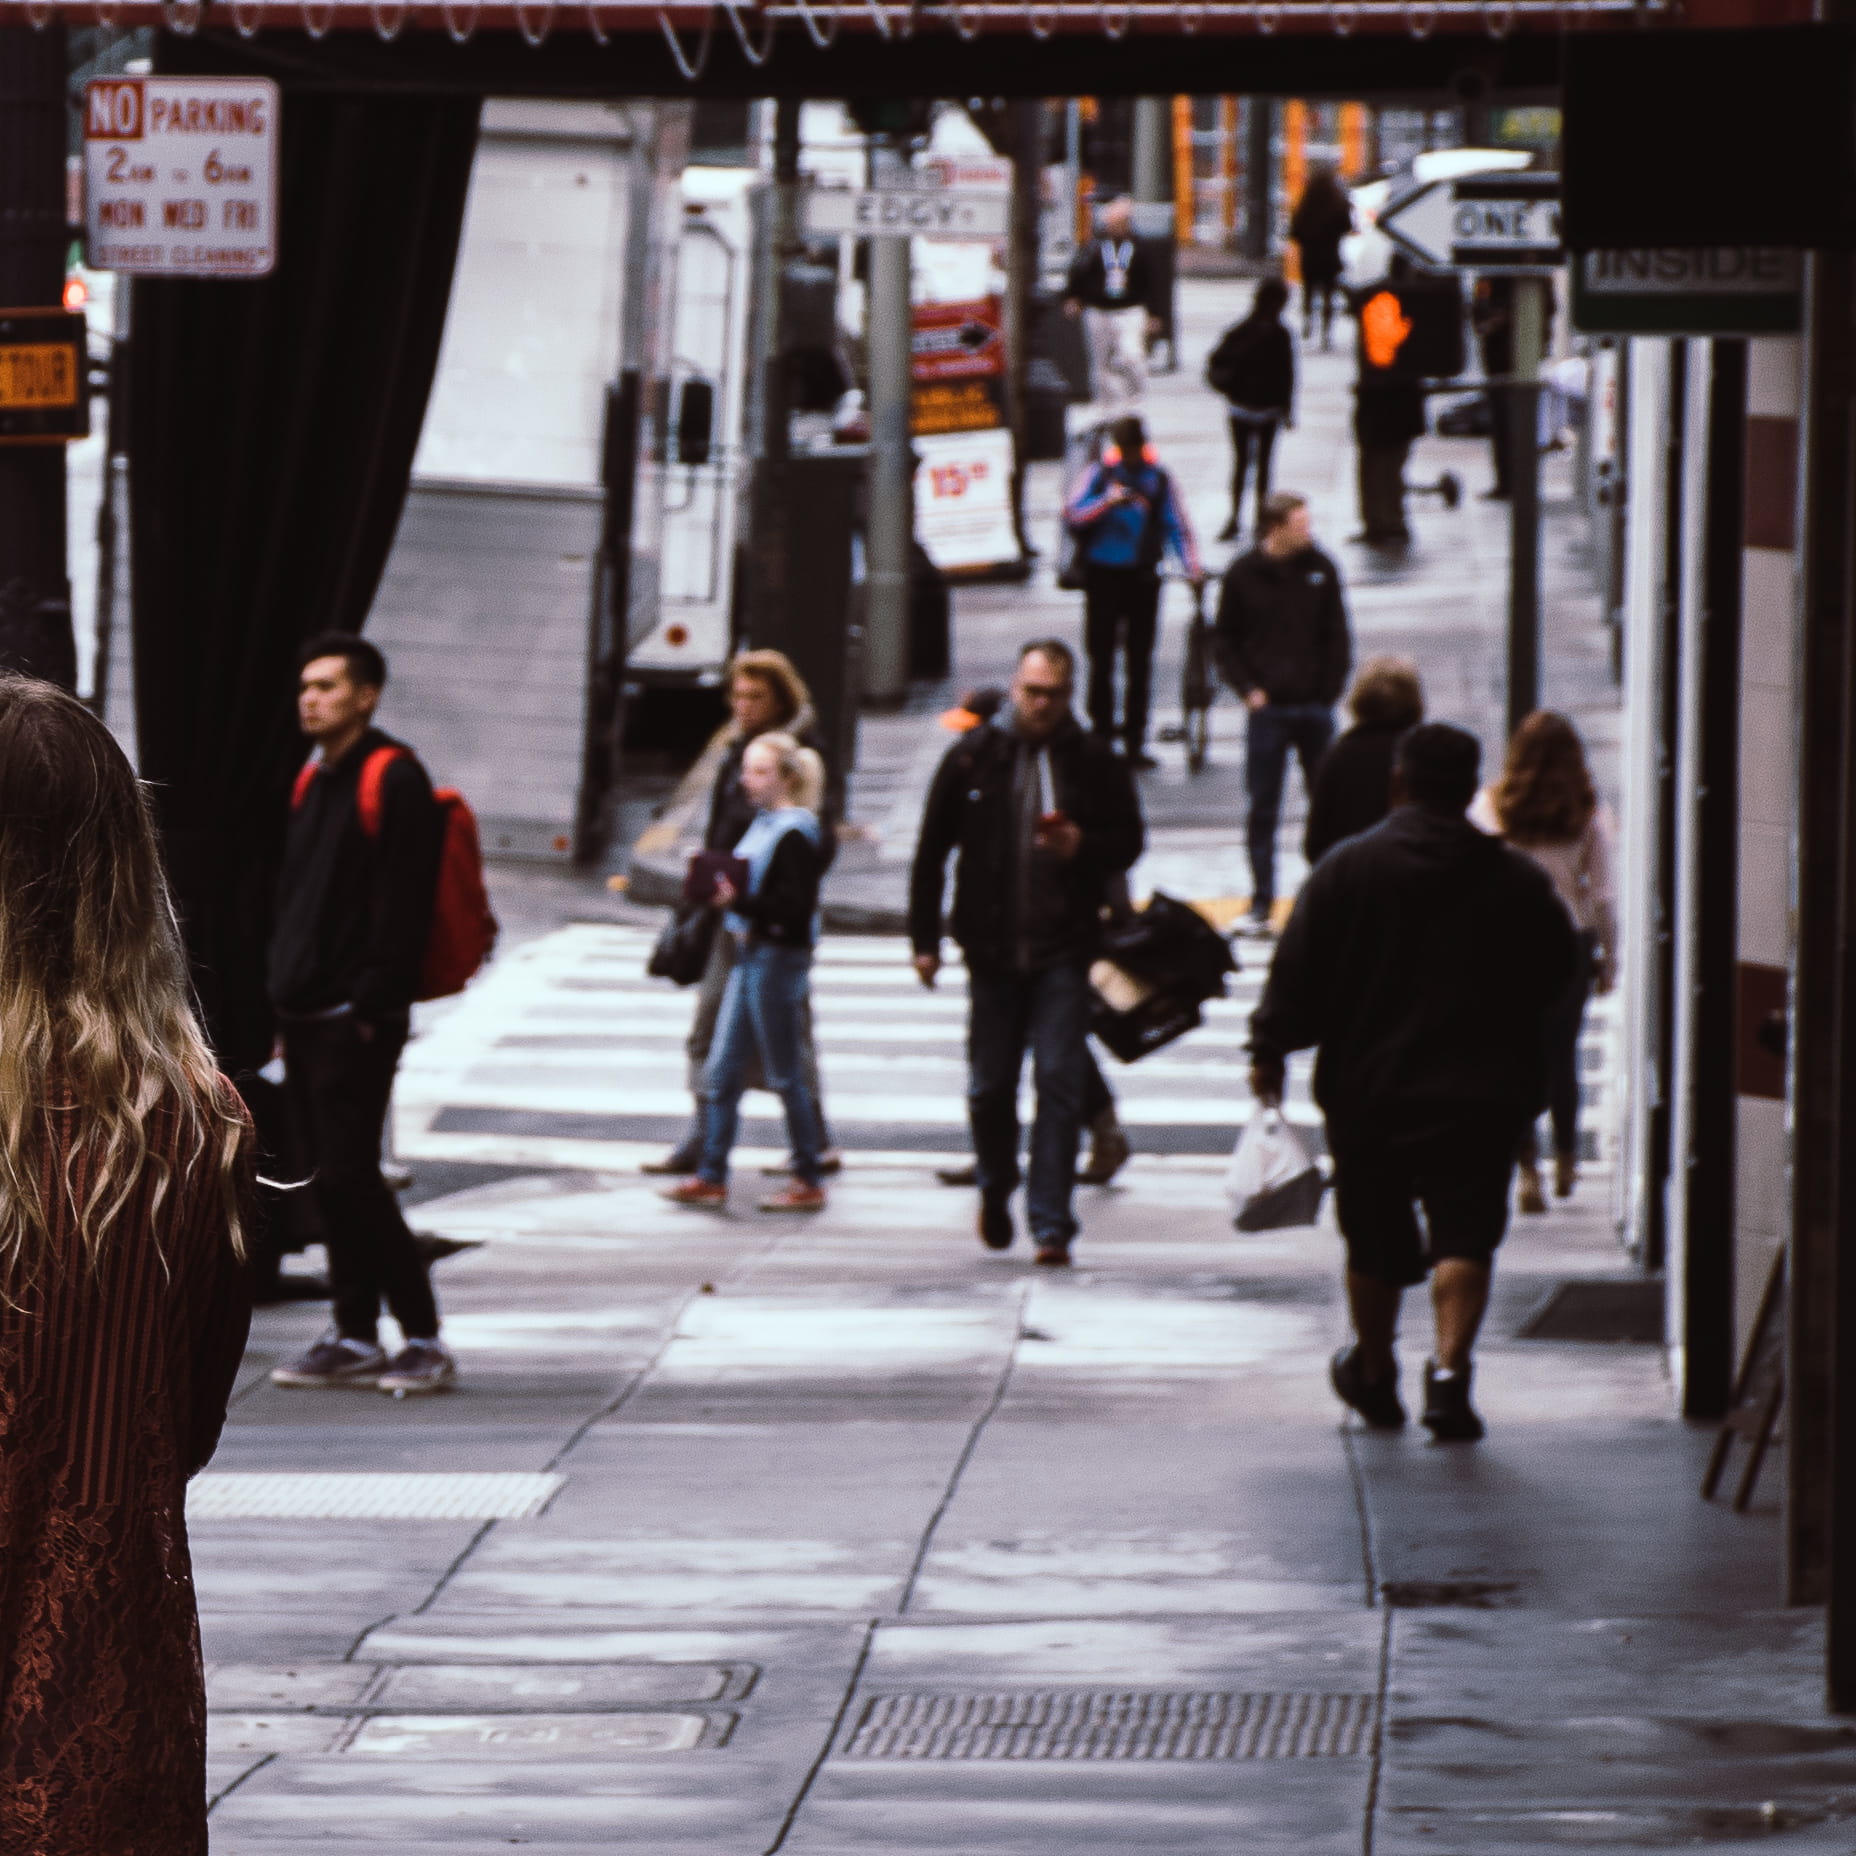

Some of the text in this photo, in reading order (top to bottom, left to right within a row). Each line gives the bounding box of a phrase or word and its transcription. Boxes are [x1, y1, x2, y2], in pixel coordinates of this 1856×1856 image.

[91, 84, 265, 135] NO PARKING
[99, 199, 257, 232] MON WED FRI
[1454, 204, 1530, 240] ONE
